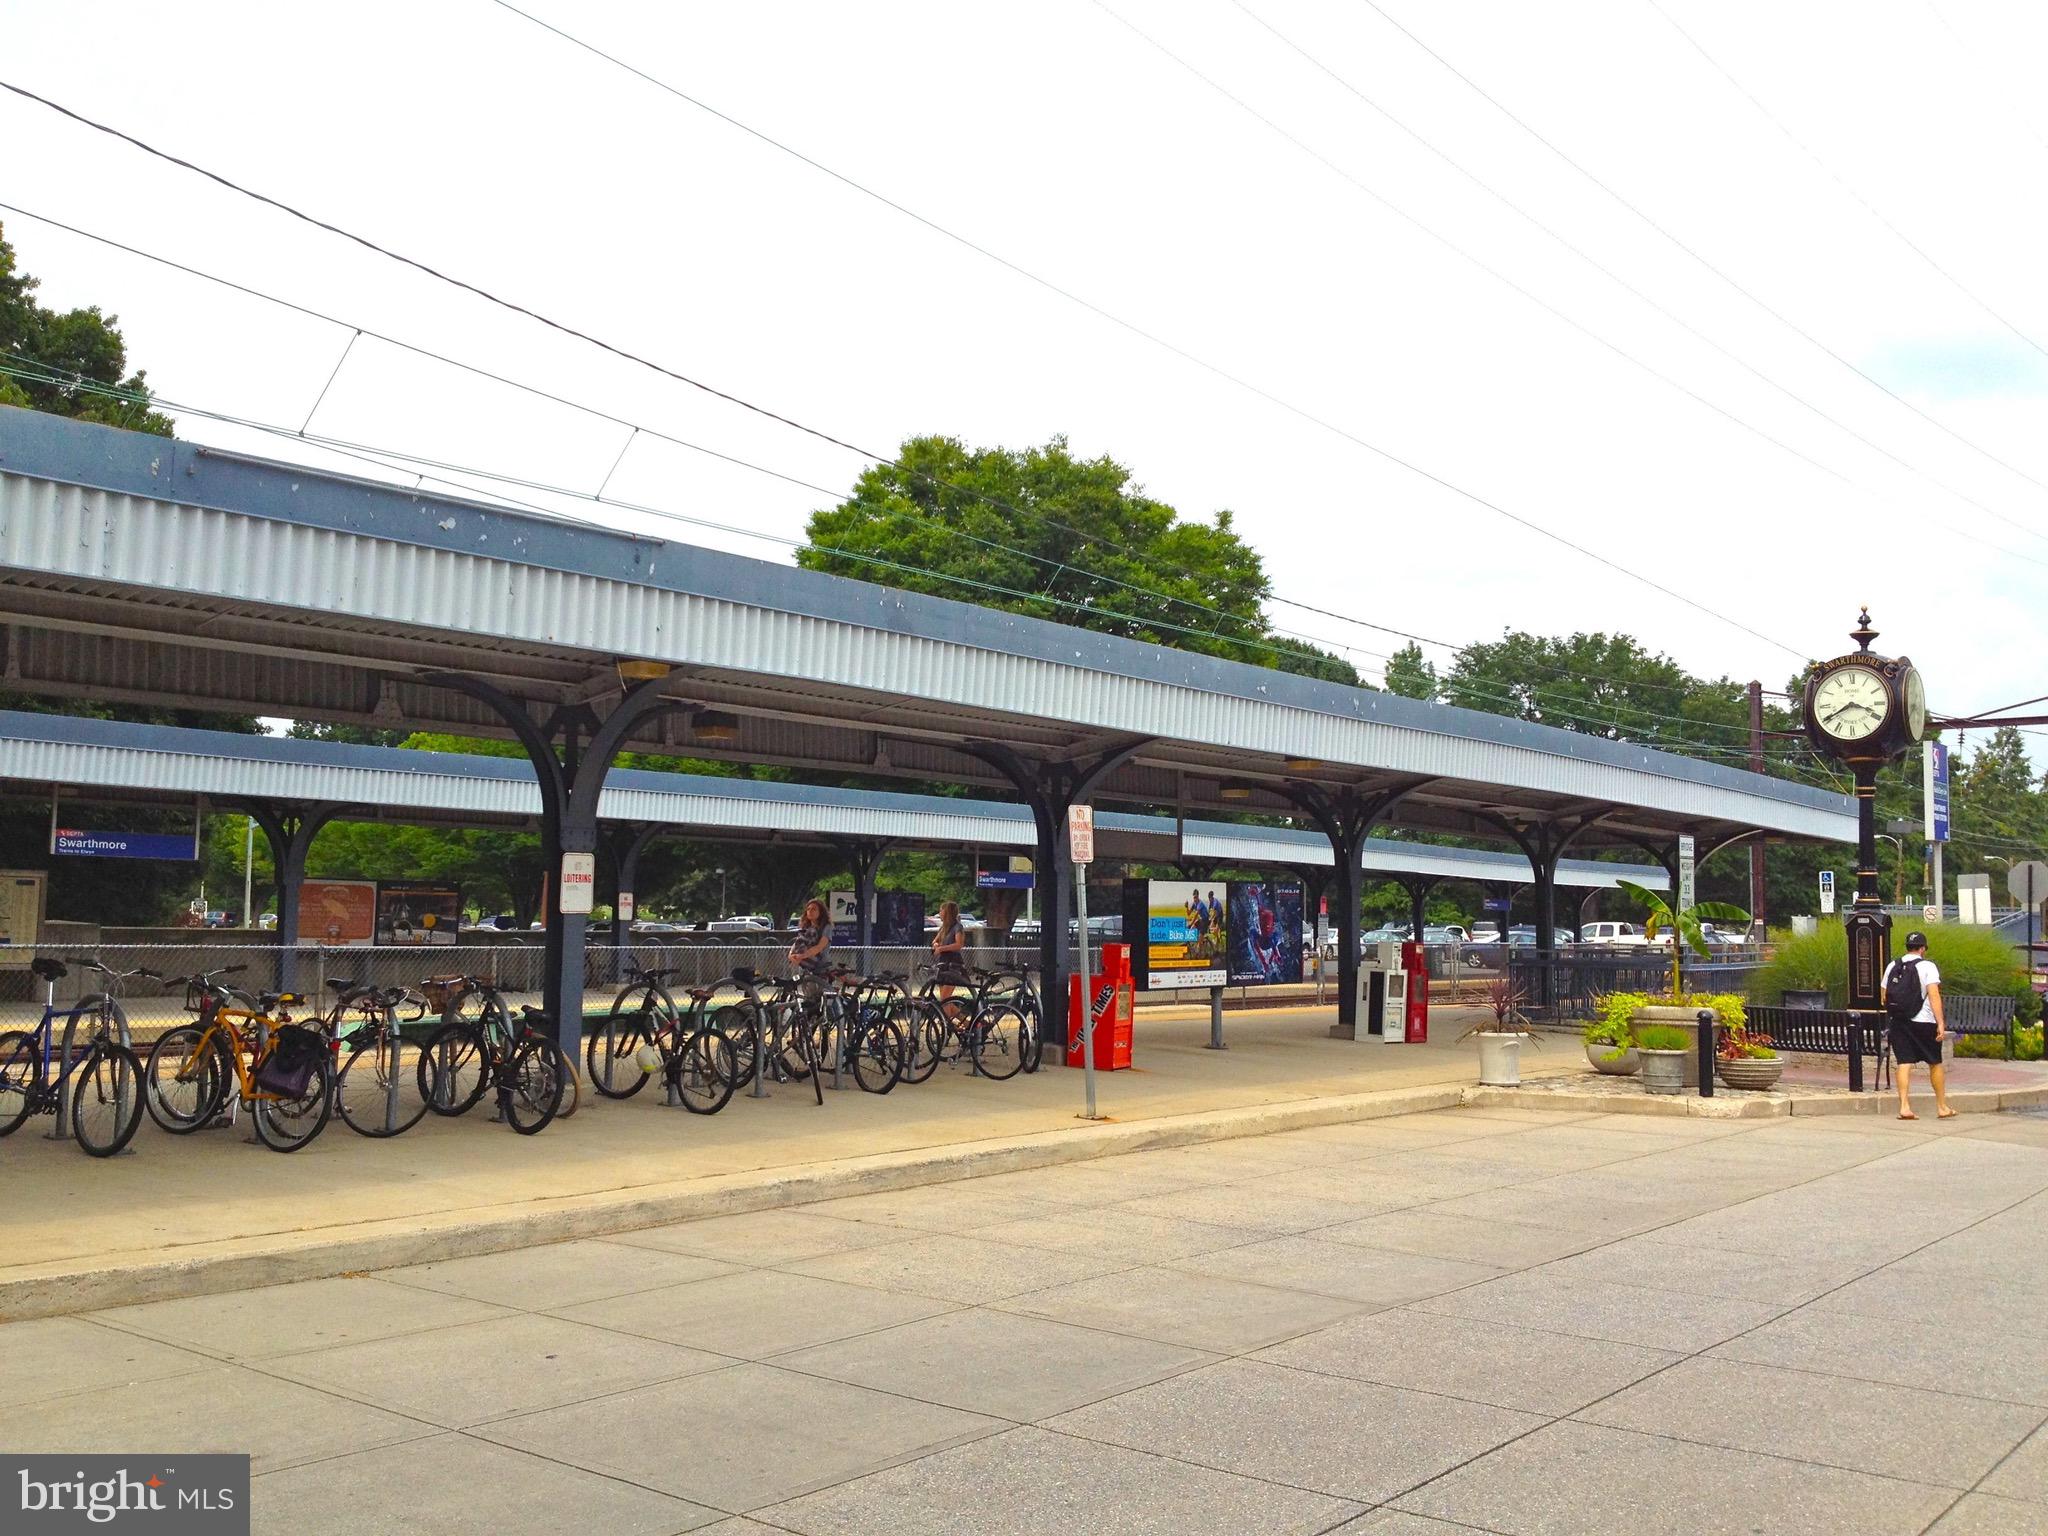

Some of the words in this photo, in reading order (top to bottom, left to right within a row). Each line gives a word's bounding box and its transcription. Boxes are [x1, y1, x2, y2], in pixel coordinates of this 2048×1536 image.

[1823, 655, 1880, 669] SWARTHMORE
[1076, 809, 1085, 821] NO
[1071, 821, 1091, 831] PARKING
[59, 837, 127, 849] Swarthmore
[563, 873, 592, 884] LOITERING
[1151, 918, 1170, 929] Don't
[1169, 930, 1184, 940] Bike
[1091, 984, 1115, 1015] TIMES
